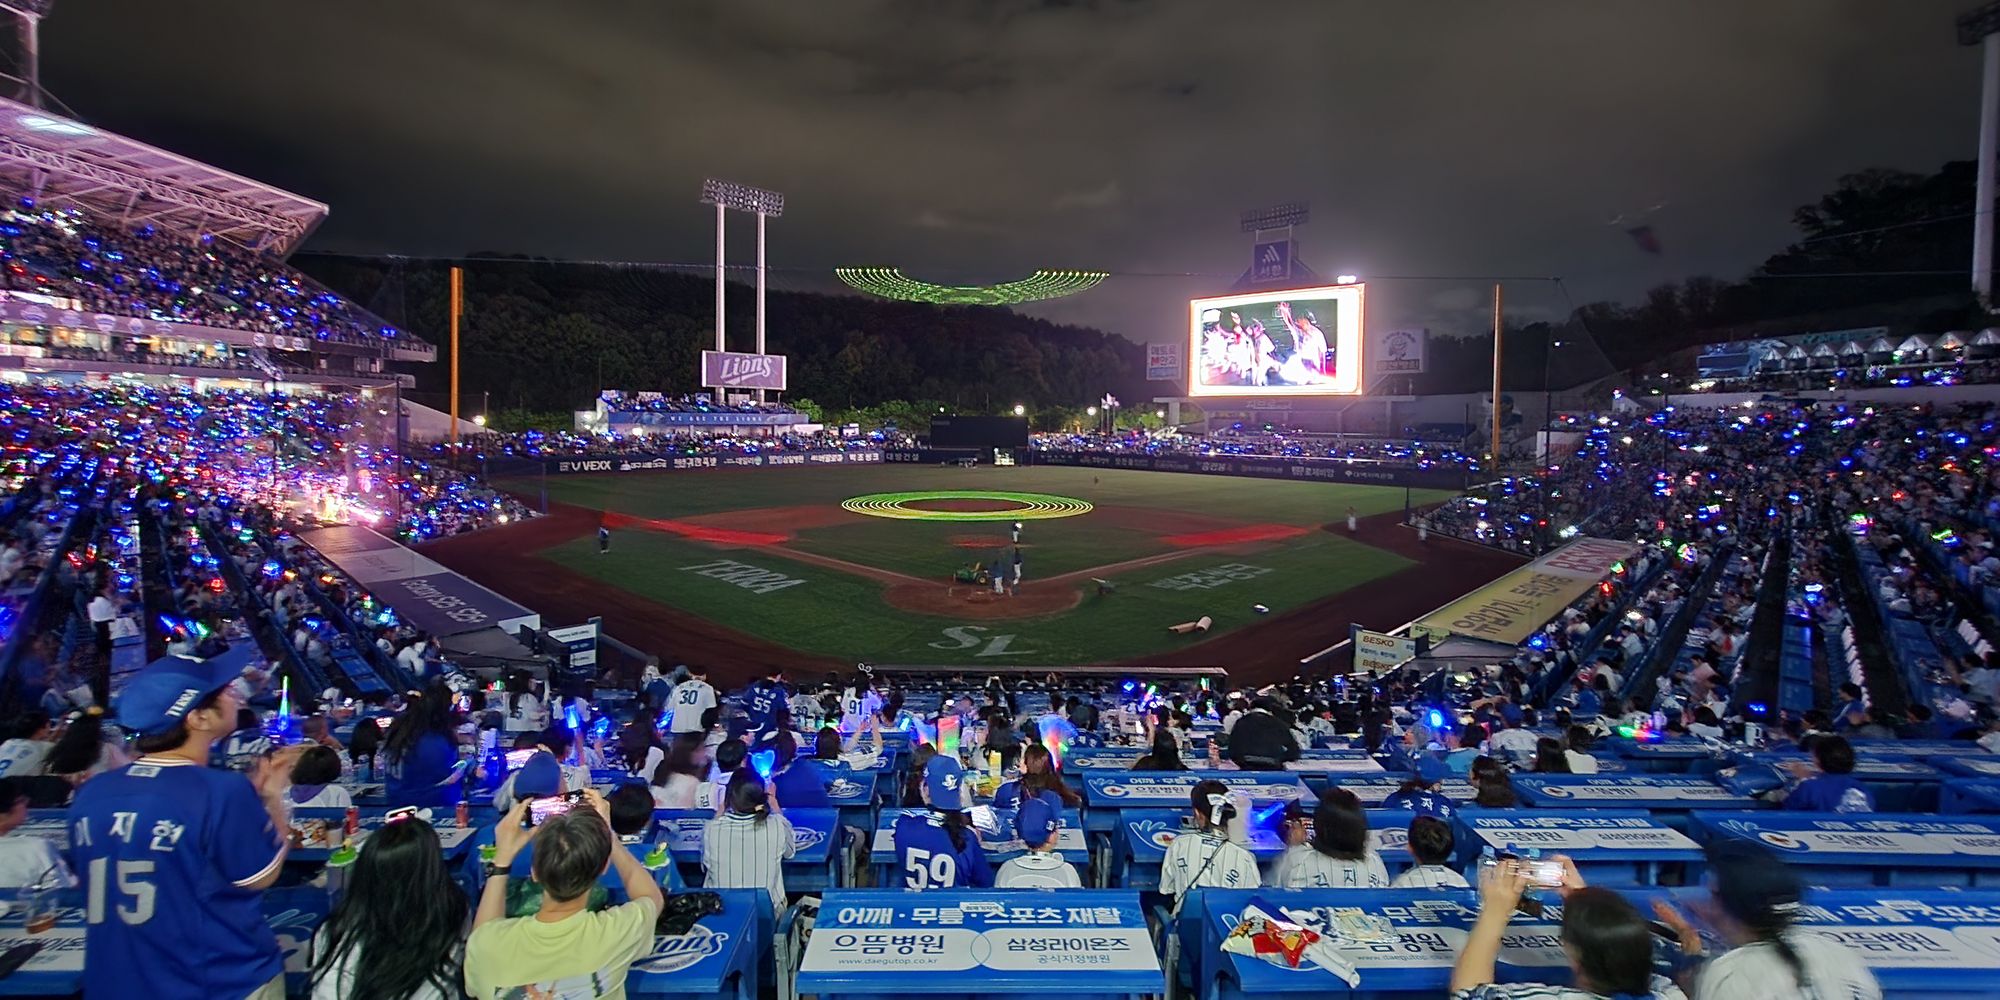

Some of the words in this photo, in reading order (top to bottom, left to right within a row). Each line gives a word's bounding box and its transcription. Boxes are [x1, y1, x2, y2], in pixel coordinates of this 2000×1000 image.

[720, 355, 773, 379] Lions
[583, 461, 611, 471] VEXX
[676, 559, 807, 595] TERRA
[1363, 635, 1395, 648] BESKO
[680, 690, 698, 704] 30
[752, 696, 771, 714] 55
[849, 699, 863, 715] 91
[905, 847, 956, 889] 59
[88, 857, 157, 926] 15
[838, 907, 893, 925] 어깨
[911, 907, 965, 925] 무릎
[983, 907, 1064, 925] 스포츠
[1066, 907, 1122, 925] 재활
[829, 934, 946, 956] 으뜸병원
[1007, 937, 1131, 953] 삼성라이온즈
[838, 957, 938, 967] www.daegutop.co.kr
[1037, 954, 1112, 965] 공식지정병원
